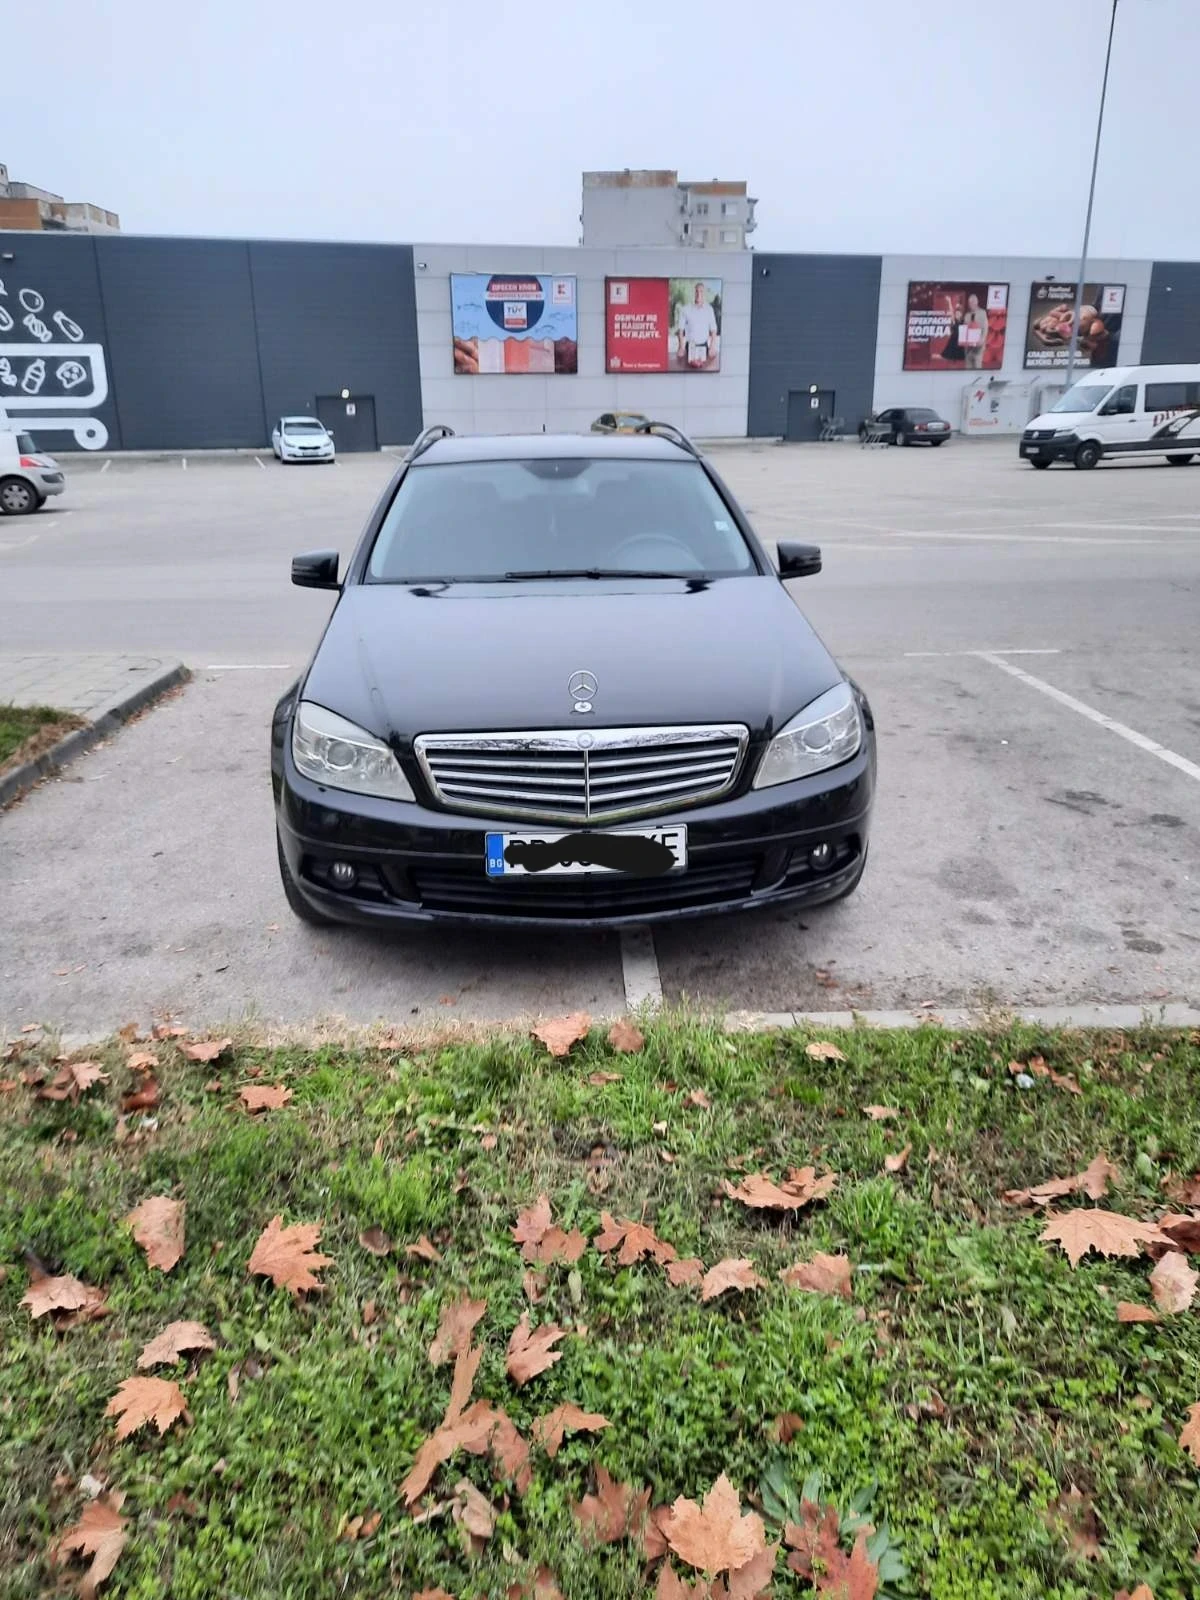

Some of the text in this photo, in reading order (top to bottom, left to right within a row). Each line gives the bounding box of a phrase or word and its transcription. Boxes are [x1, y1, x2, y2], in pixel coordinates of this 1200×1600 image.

[908, 317, 952, 325] ПРЕКРАСНА
[908, 326, 951, 337] КОЛЕДА
[489, 859, 503, 868] BG
